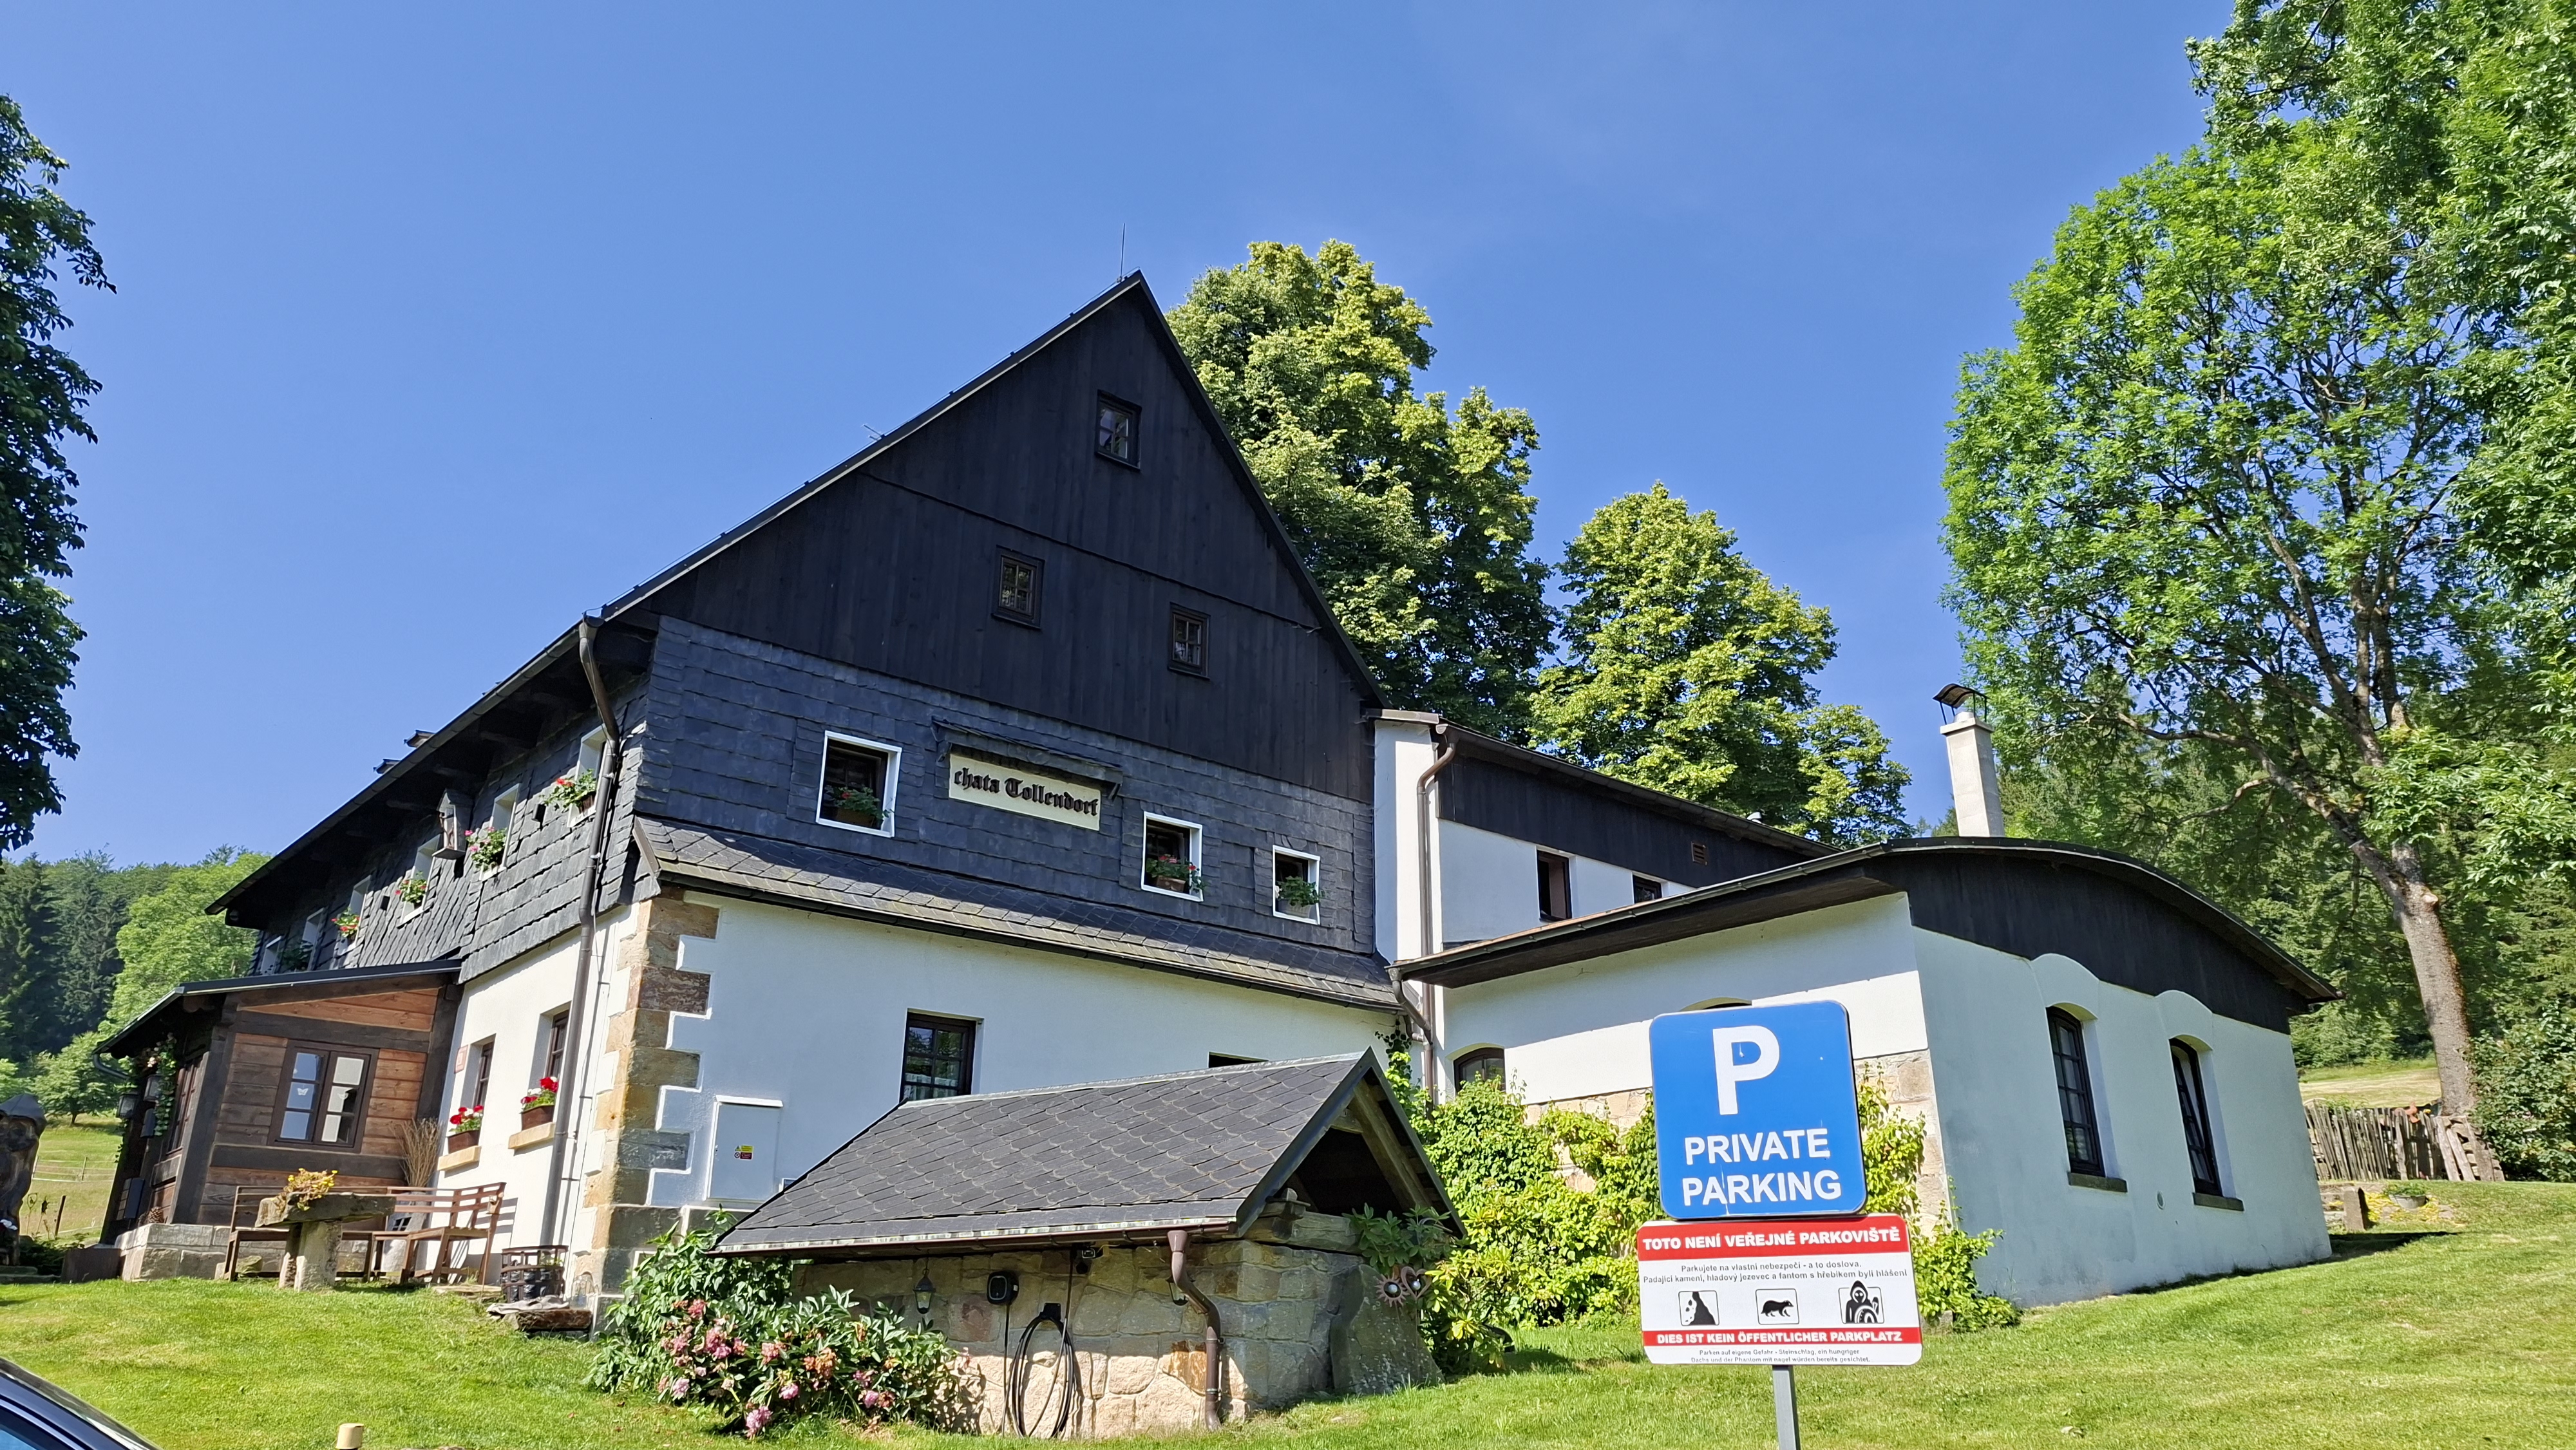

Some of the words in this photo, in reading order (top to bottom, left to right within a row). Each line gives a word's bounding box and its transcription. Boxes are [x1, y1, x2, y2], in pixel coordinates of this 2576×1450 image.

[1004, 777, 1099, 816] Tollendorf
[1712, 1024, 1780, 1116] P
[1684, 1127, 1831, 1165] PRIVATE
[1681, 1169, 1842, 1207] PARKING
[1642, 1237, 1681, 1250] TOTO
[1685, 1233, 1721, 1248] NENÍ
[1724, 1230, 1796, 1247] VEŘEJNÉ
[1799, 1226, 1900, 1245] PARKOVIŠTĚ
[1681, 1265, 1717, 1274] Parkujete
[1731, 1263, 1757, 1271] vlastní
[1759, 1261, 1801, 1270] nebezpečí
[1826, 1260, 1862, 1268] doslova.
[1707, 1273, 1738, 1283] hladový
[1739, 1273, 1770, 1283] jezevec
[1817, 1270, 1856, 1279] hřebíkem
[1858, 1269, 1874, 1279] byli
[1657, 1334, 1683, 1344] DIES
[1685, 1333, 1705, 1344] IST
[1707, 1333, 1736, 1343] KEIN
[1738, 1331, 1828, 1343] ÖFFENTLICHER
[1830, 1331, 1903, 1342] PARKPLATZ
